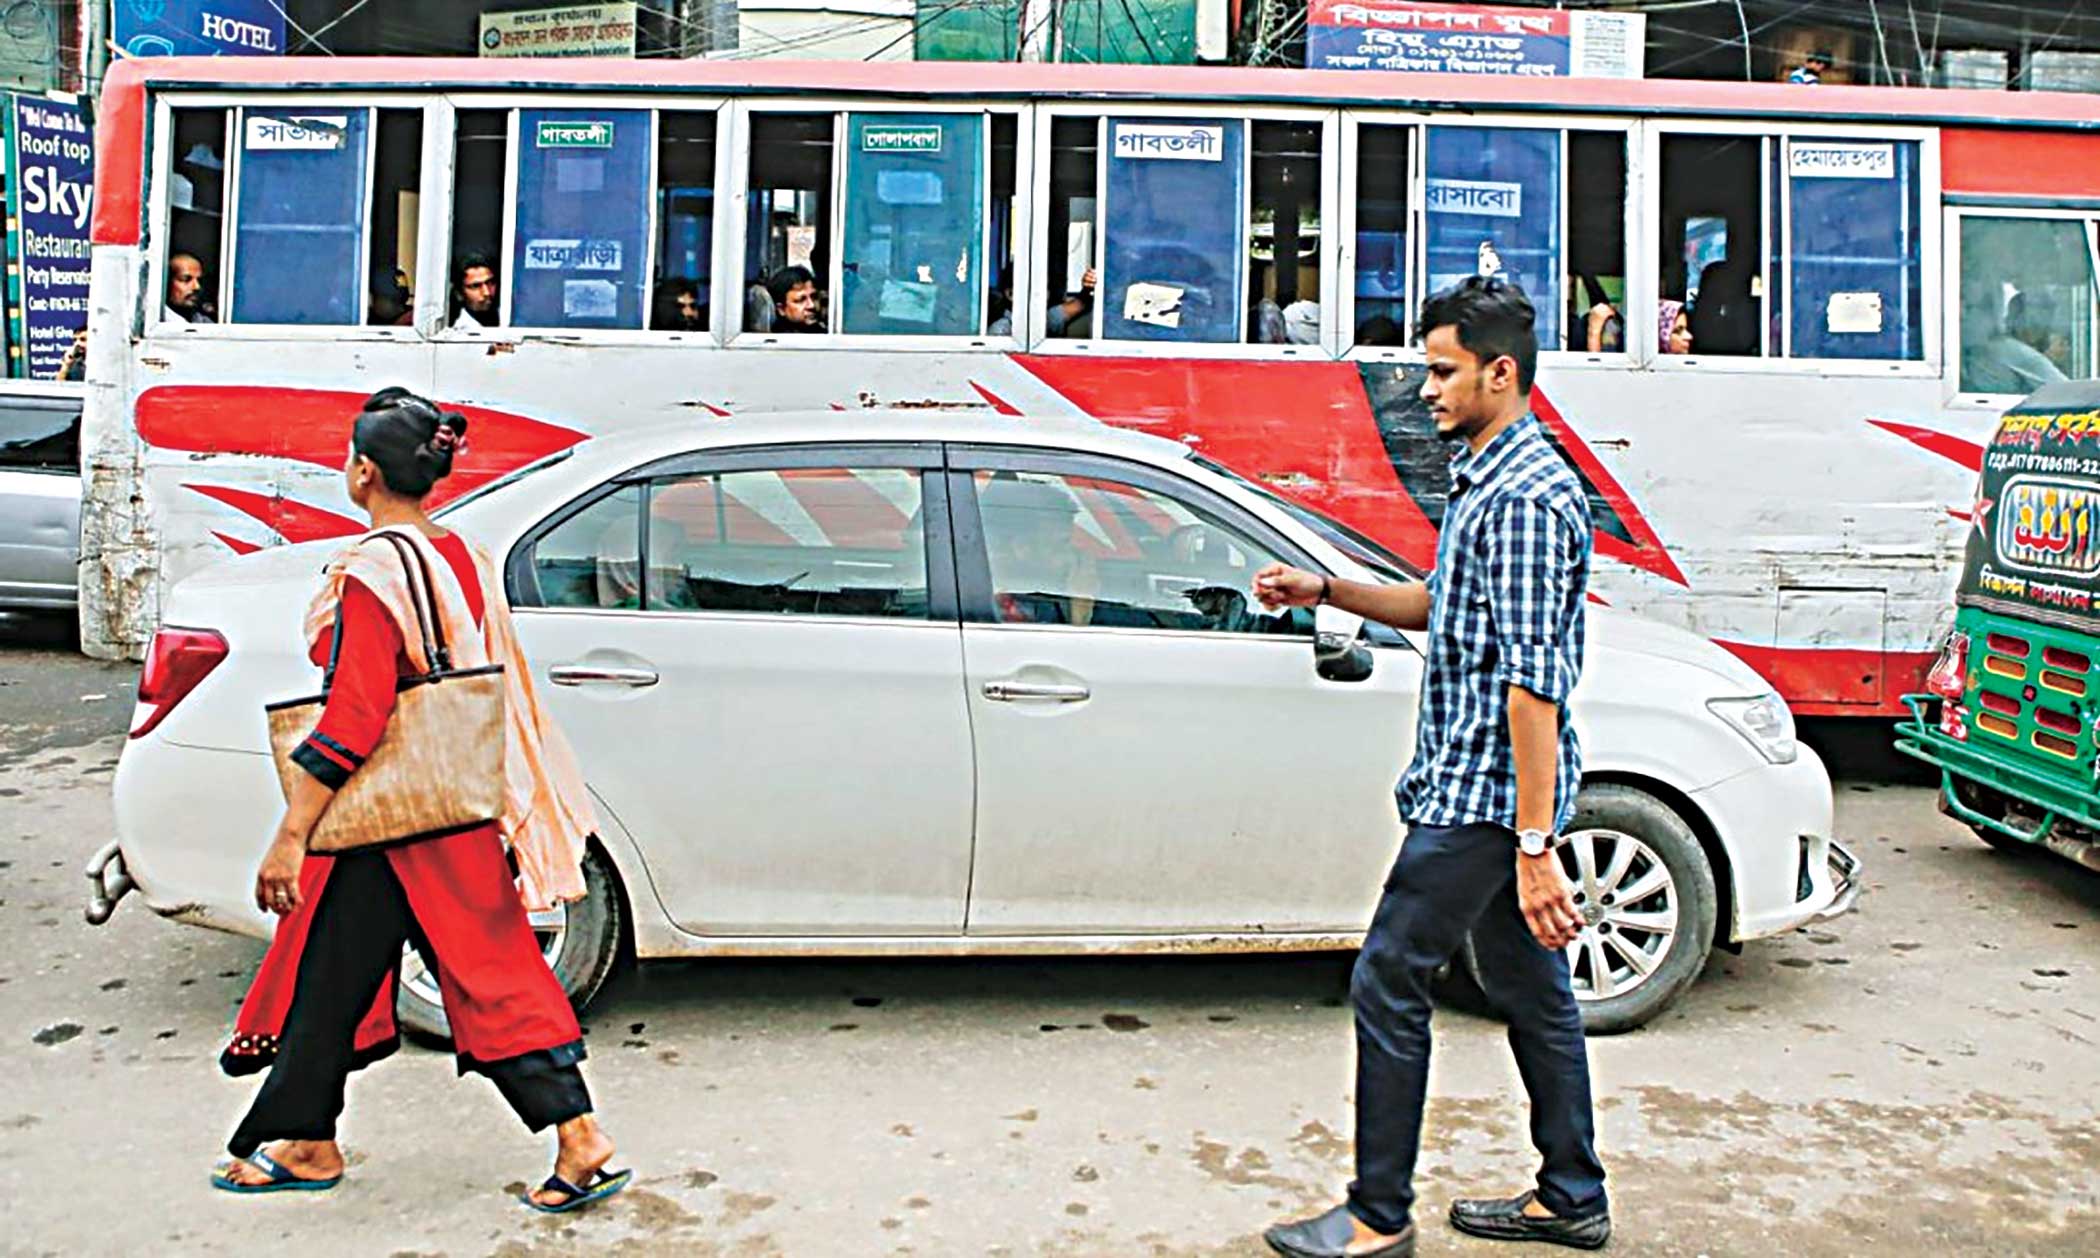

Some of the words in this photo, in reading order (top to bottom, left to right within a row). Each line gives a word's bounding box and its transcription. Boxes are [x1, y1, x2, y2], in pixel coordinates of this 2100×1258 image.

[201, 12, 278, 51] HOTEL
[541, 122, 608, 144] গাবতলী
[1119, 129, 1216, 154] গাবতলী
[21, 131, 60, 156] Roof
[63, 139, 91, 165] top
[1792, 149, 1888, 171] হেমায়েতপুর
[24, 166, 94, 230] Sky
[1426, 184, 1516, 208] বাসাবো
[27, 265, 49, 289] Party
[30, 326, 53, 339] Hotel
